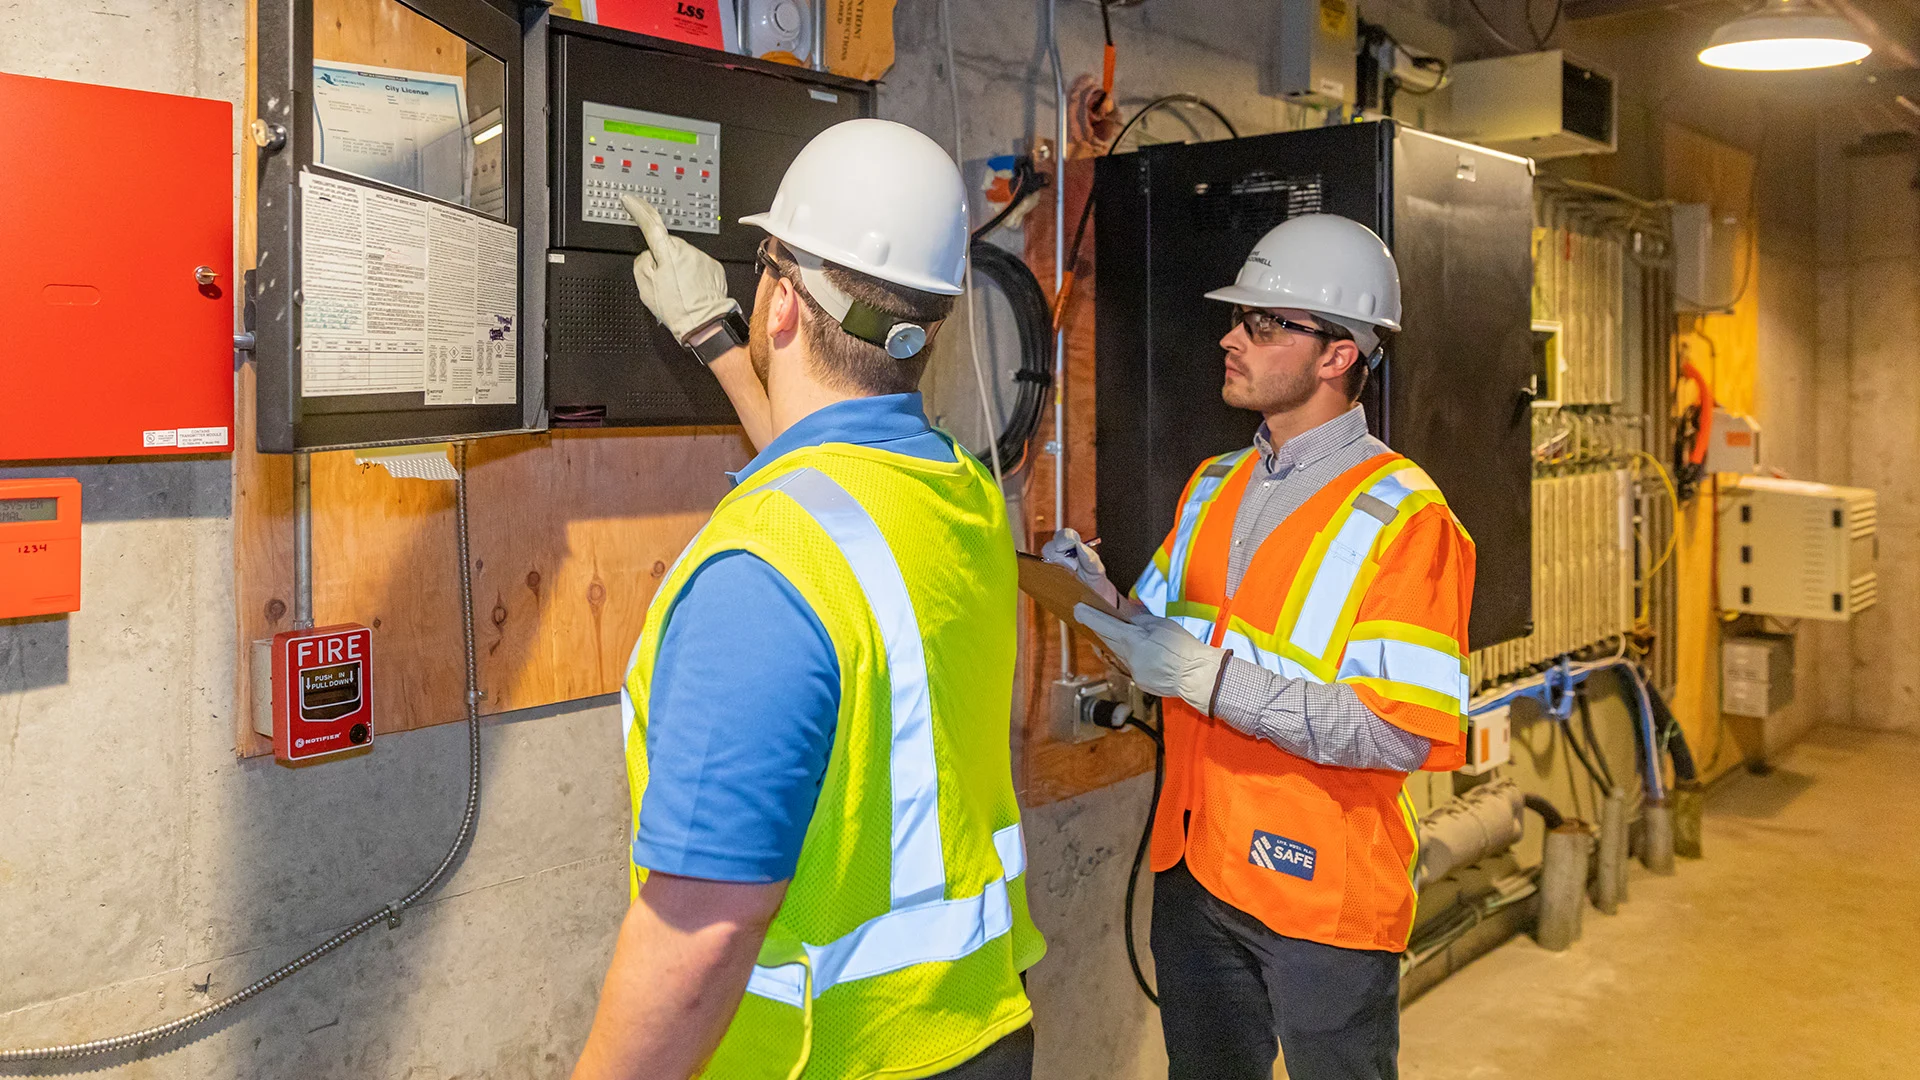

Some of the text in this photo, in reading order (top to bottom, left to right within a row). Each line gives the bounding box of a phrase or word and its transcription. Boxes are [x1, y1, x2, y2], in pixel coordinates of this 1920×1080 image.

[677, 2, 705, 20] LSS
[385, 85, 429, 96] City License
[0, 511, 22, 521] MAL
[18, 543, 47, 554] 1234
[298, 635, 362, 666] FIRE
[329, 678, 350, 687] DOWN
[306, 734, 340, 744] NOTIFIER
[1274, 846, 1314, 869] SAFE
